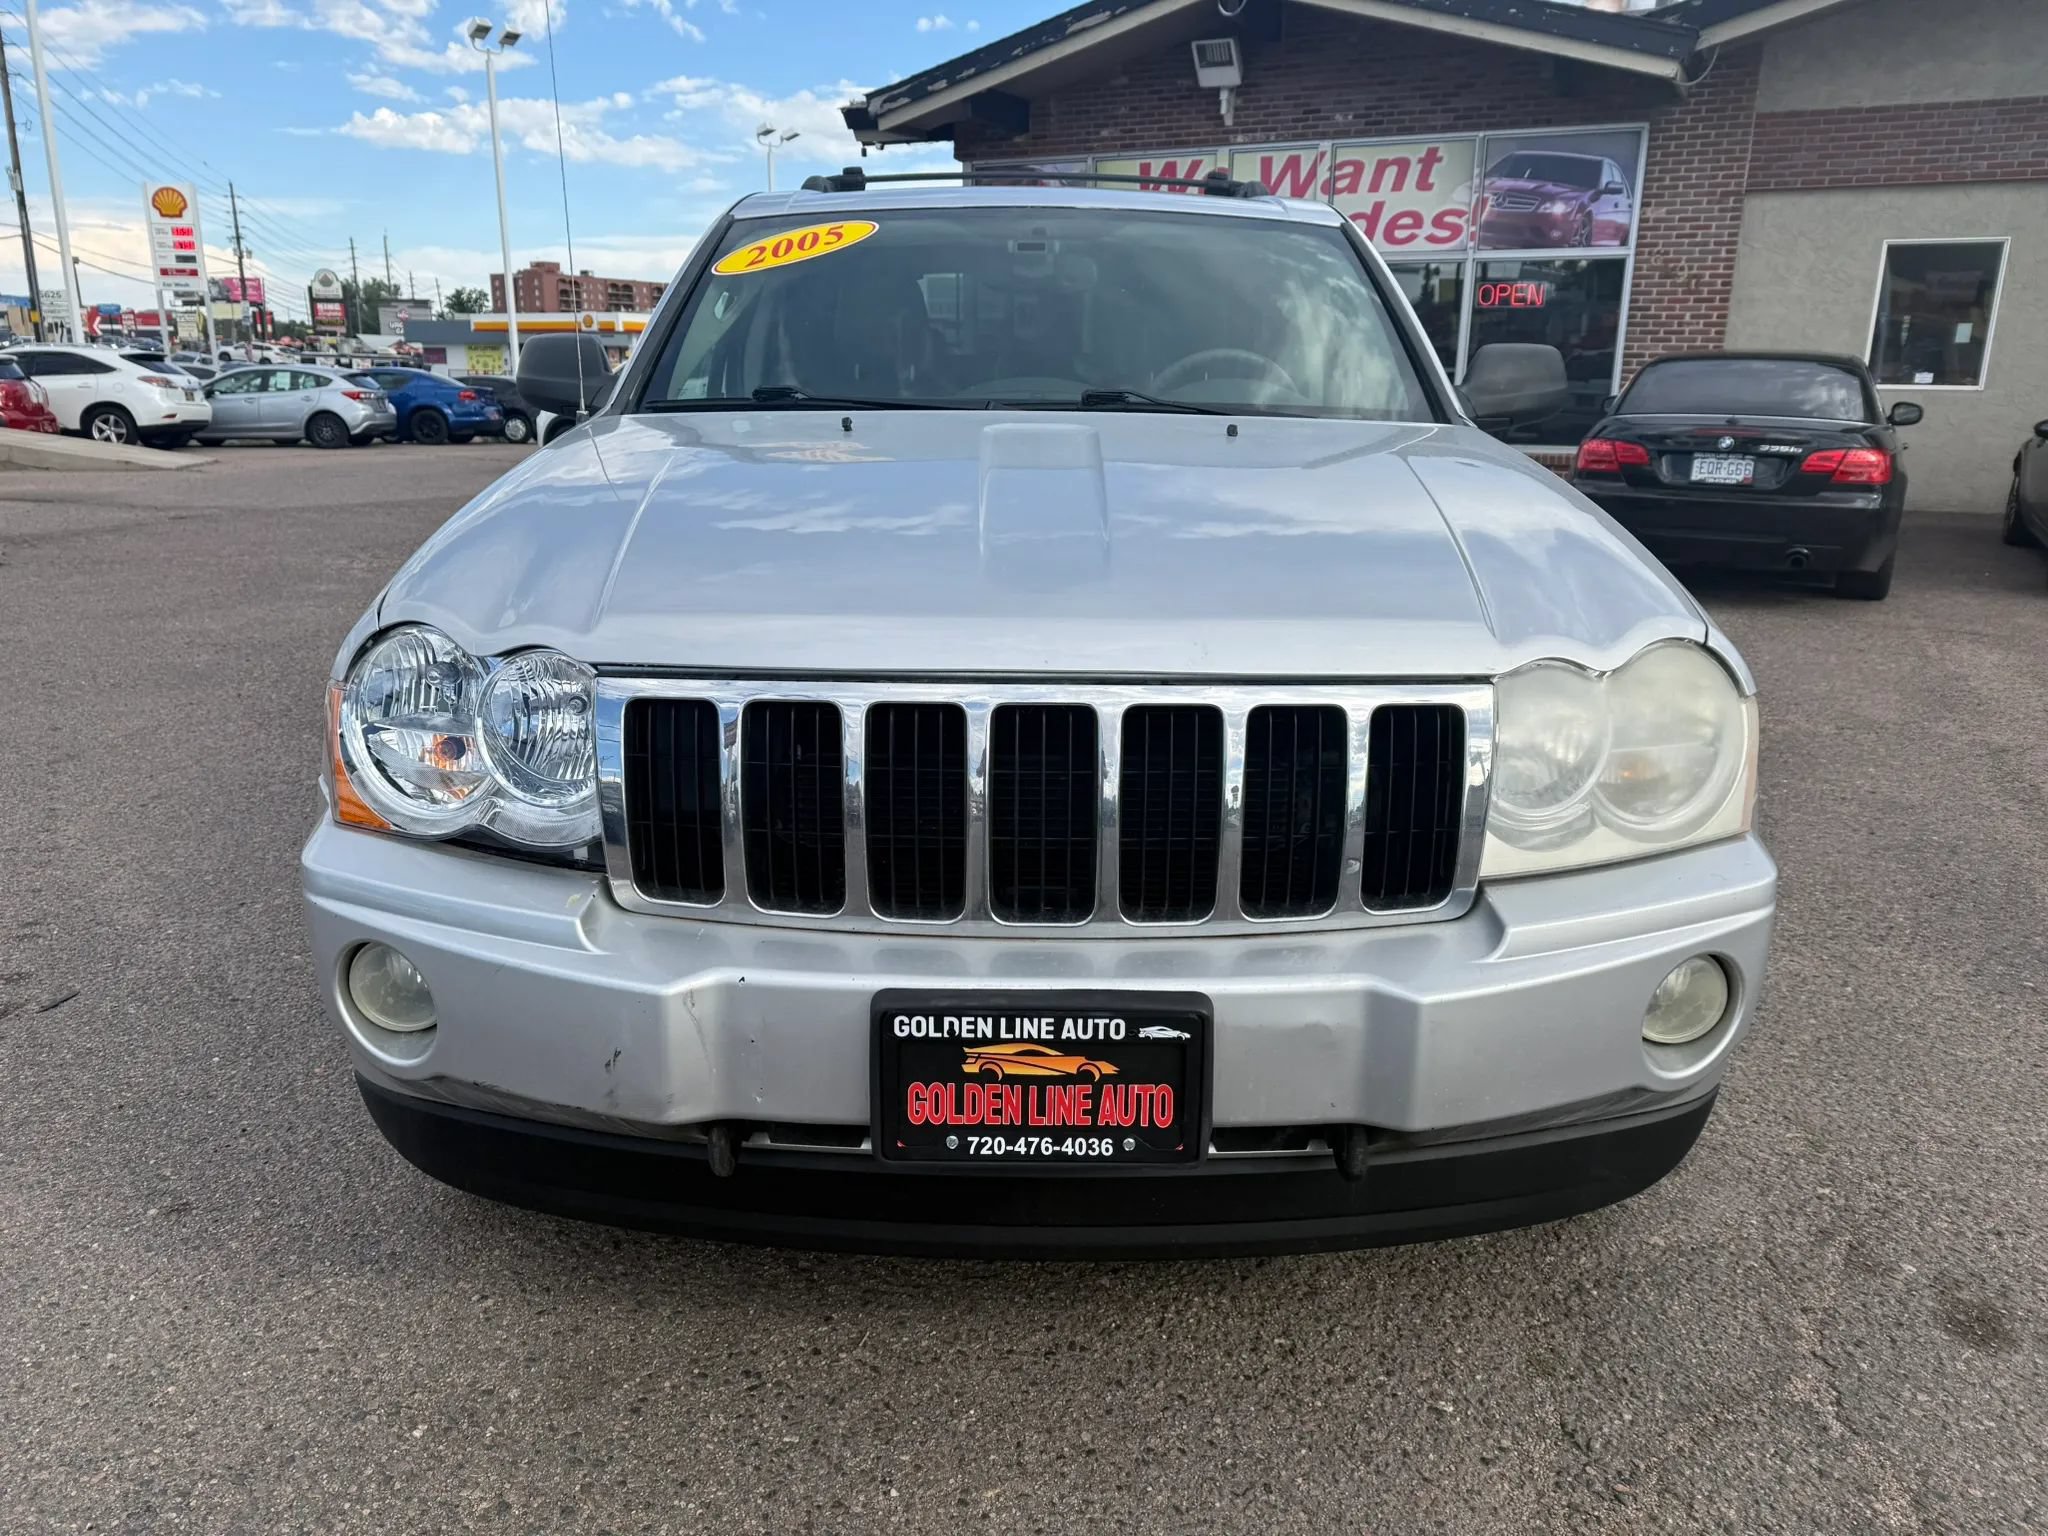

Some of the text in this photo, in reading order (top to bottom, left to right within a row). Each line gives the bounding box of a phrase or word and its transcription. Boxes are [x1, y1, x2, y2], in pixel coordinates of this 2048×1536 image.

[1260, 146, 1444, 198] Want
[745, 224, 844, 268] 2005
[1478, 283, 1546, 307] OPEN
[893, 1015, 1126, 1041] GOLDEN LINE AUTO
[906, 1081, 1174, 1129] GOLDEN LINE AUTO
[966, 1136, 1114, 1157] 720-476-4036
